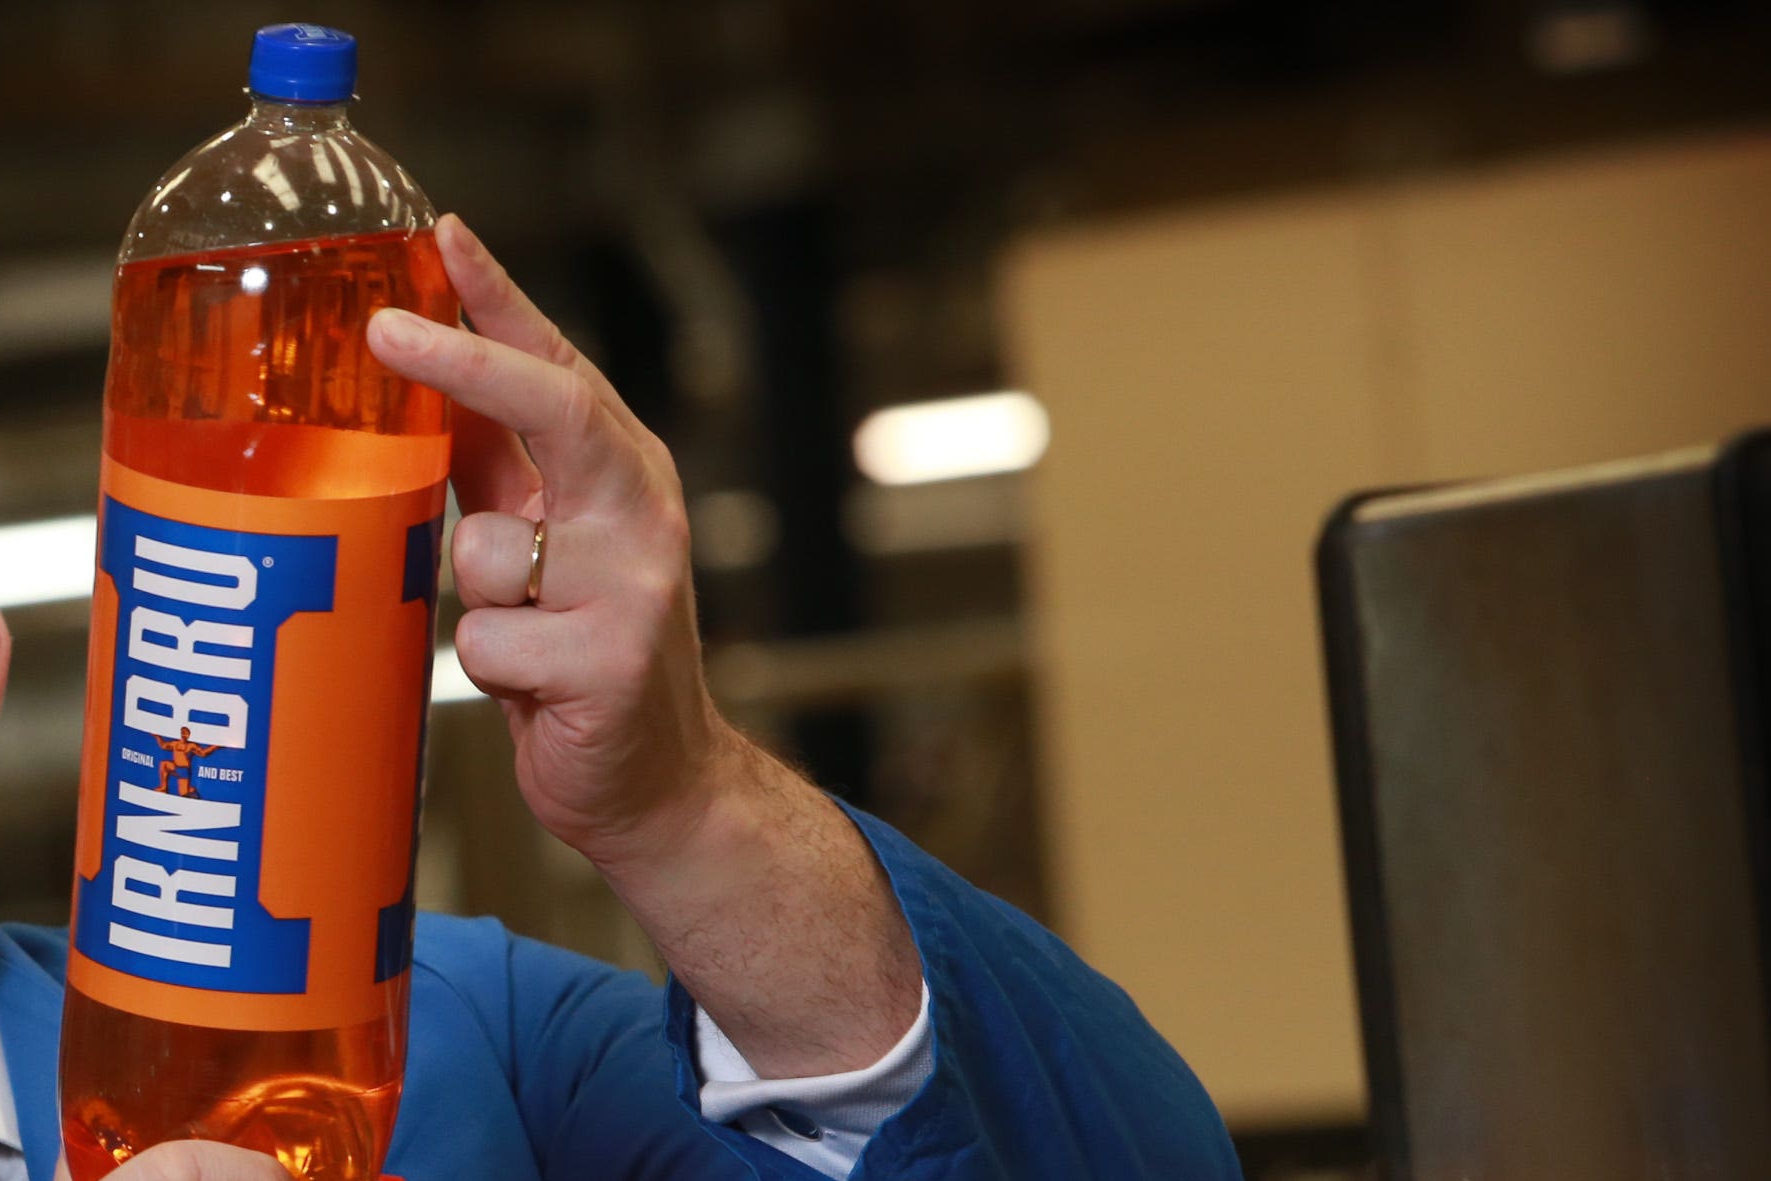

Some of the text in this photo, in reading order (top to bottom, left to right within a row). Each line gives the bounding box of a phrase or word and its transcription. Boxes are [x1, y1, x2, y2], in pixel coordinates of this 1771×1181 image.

[109, 535, 257, 968] IRN BRU
[121, 748, 154, 767] ORIGINAL
[198, 766, 244, 782] AND BEST
